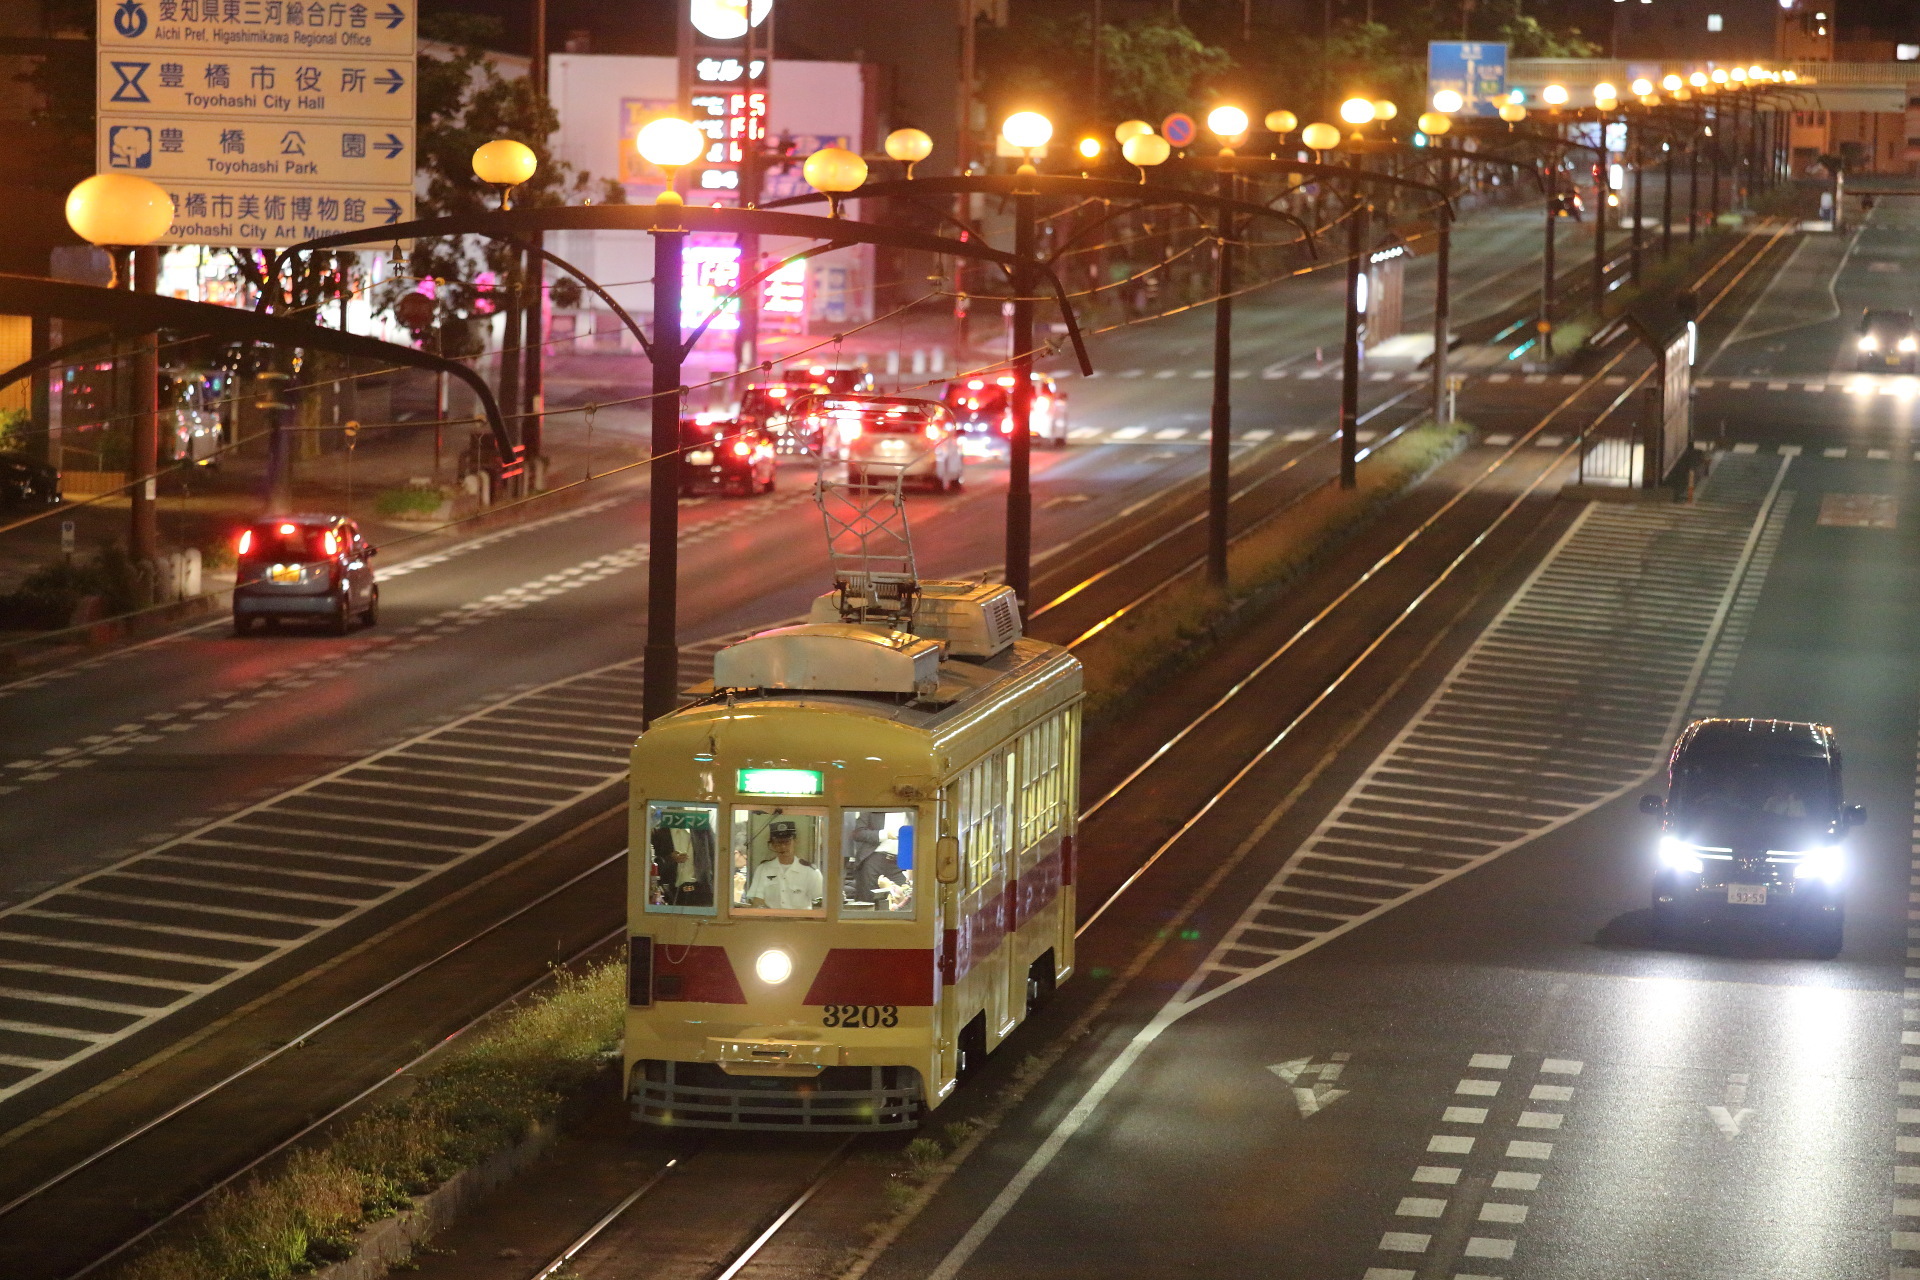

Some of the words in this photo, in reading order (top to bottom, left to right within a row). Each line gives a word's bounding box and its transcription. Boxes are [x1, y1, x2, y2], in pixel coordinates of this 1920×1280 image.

[159, 0, 368, 28] 愛知県東三河総合庁舎
[155, 27, 181, 40] Aichi
[185, 27, 208, 42] Pref.
[213, 29, 290, 45] Higashimikawa
[294, 31, 337, 47] Regional
[341, 33, 372, 46] Office
[158, 62, 366, 94] 豊橋市役所
[185, 93, 257, 110] Toyohashi
[263, 95, 291, 110] City
[298, 96, 325, 110] Hall
[158, 127, 366, 158] 豊橋公園
[207, 158, 279, 175] Toyohashi
[285, 160, 318, 174] Park
[169, 222, 233, 238] oyohashi
[240, 223, 267, 240] City
[275, 225, 296, 239] Art
[662, 814, 708, 827] ワンマン
[823, 1004, 899, 1028] 3203
